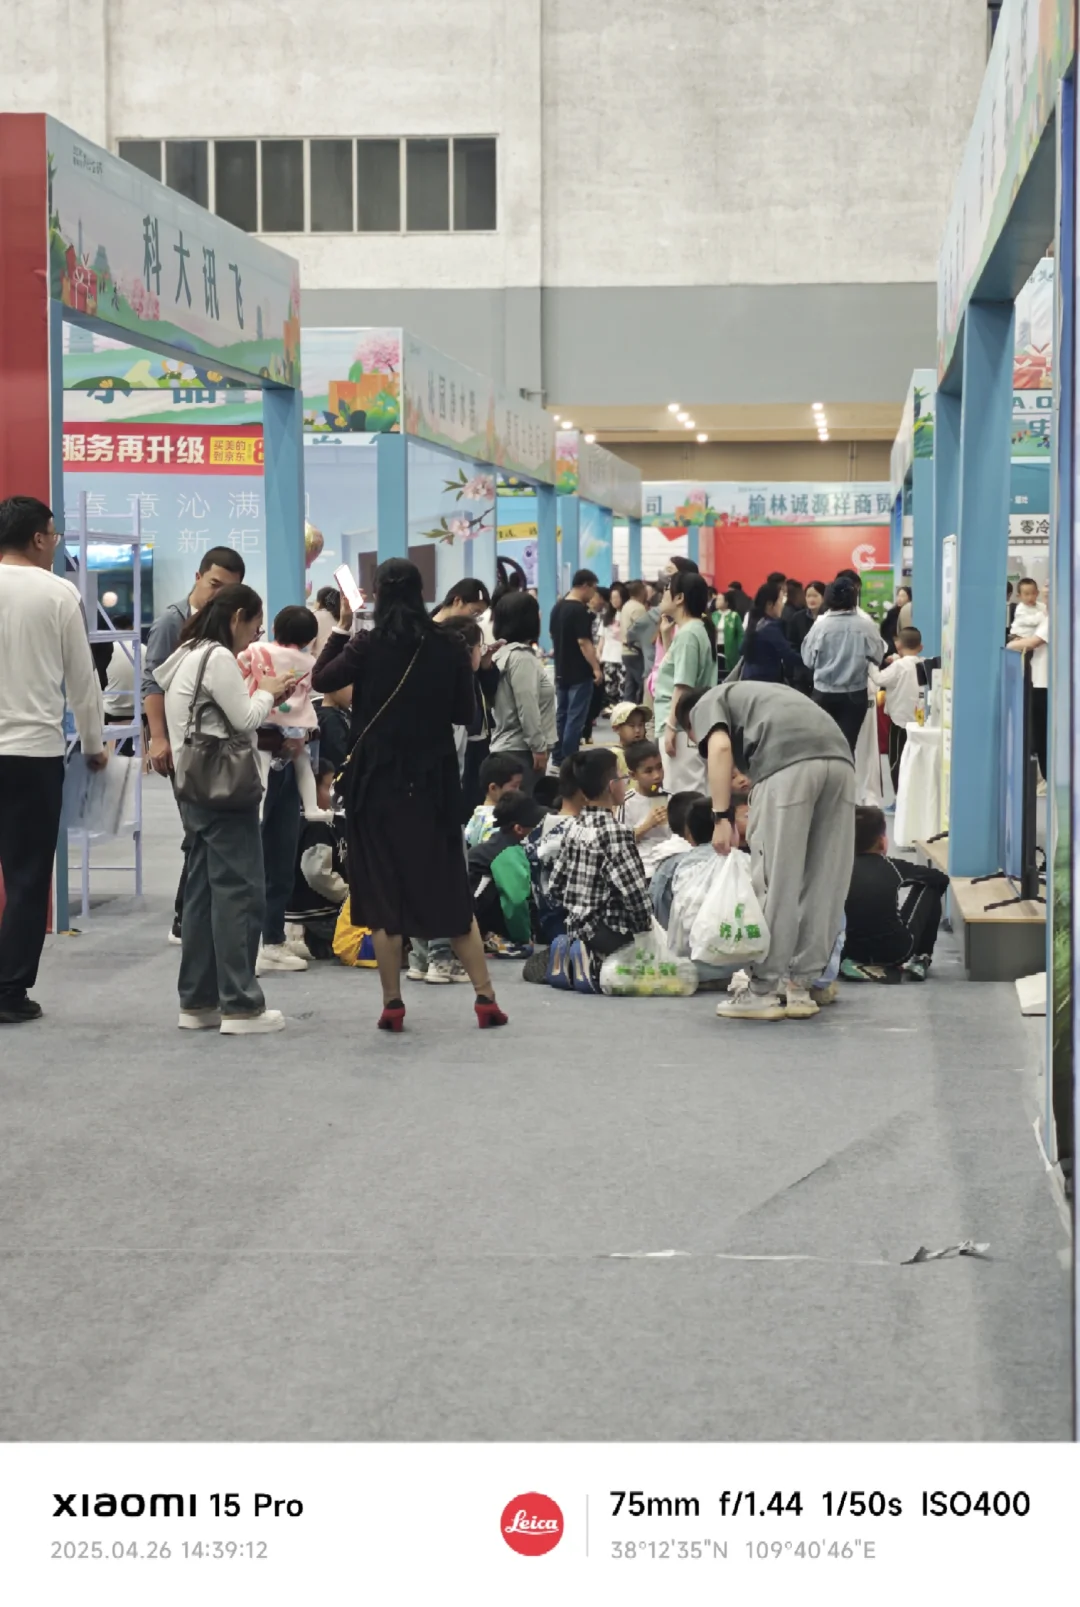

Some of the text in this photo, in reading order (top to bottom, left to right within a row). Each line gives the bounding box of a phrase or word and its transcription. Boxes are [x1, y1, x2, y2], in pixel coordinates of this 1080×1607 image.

[143, 214, 244, 330] 科大讯飞
[62, 434, 204, 464] 服务再升级
[214, 440, 245, 451] 买美的
[214, 452, 245, 462] 到京东
[646, 495, 663, 515] 司
